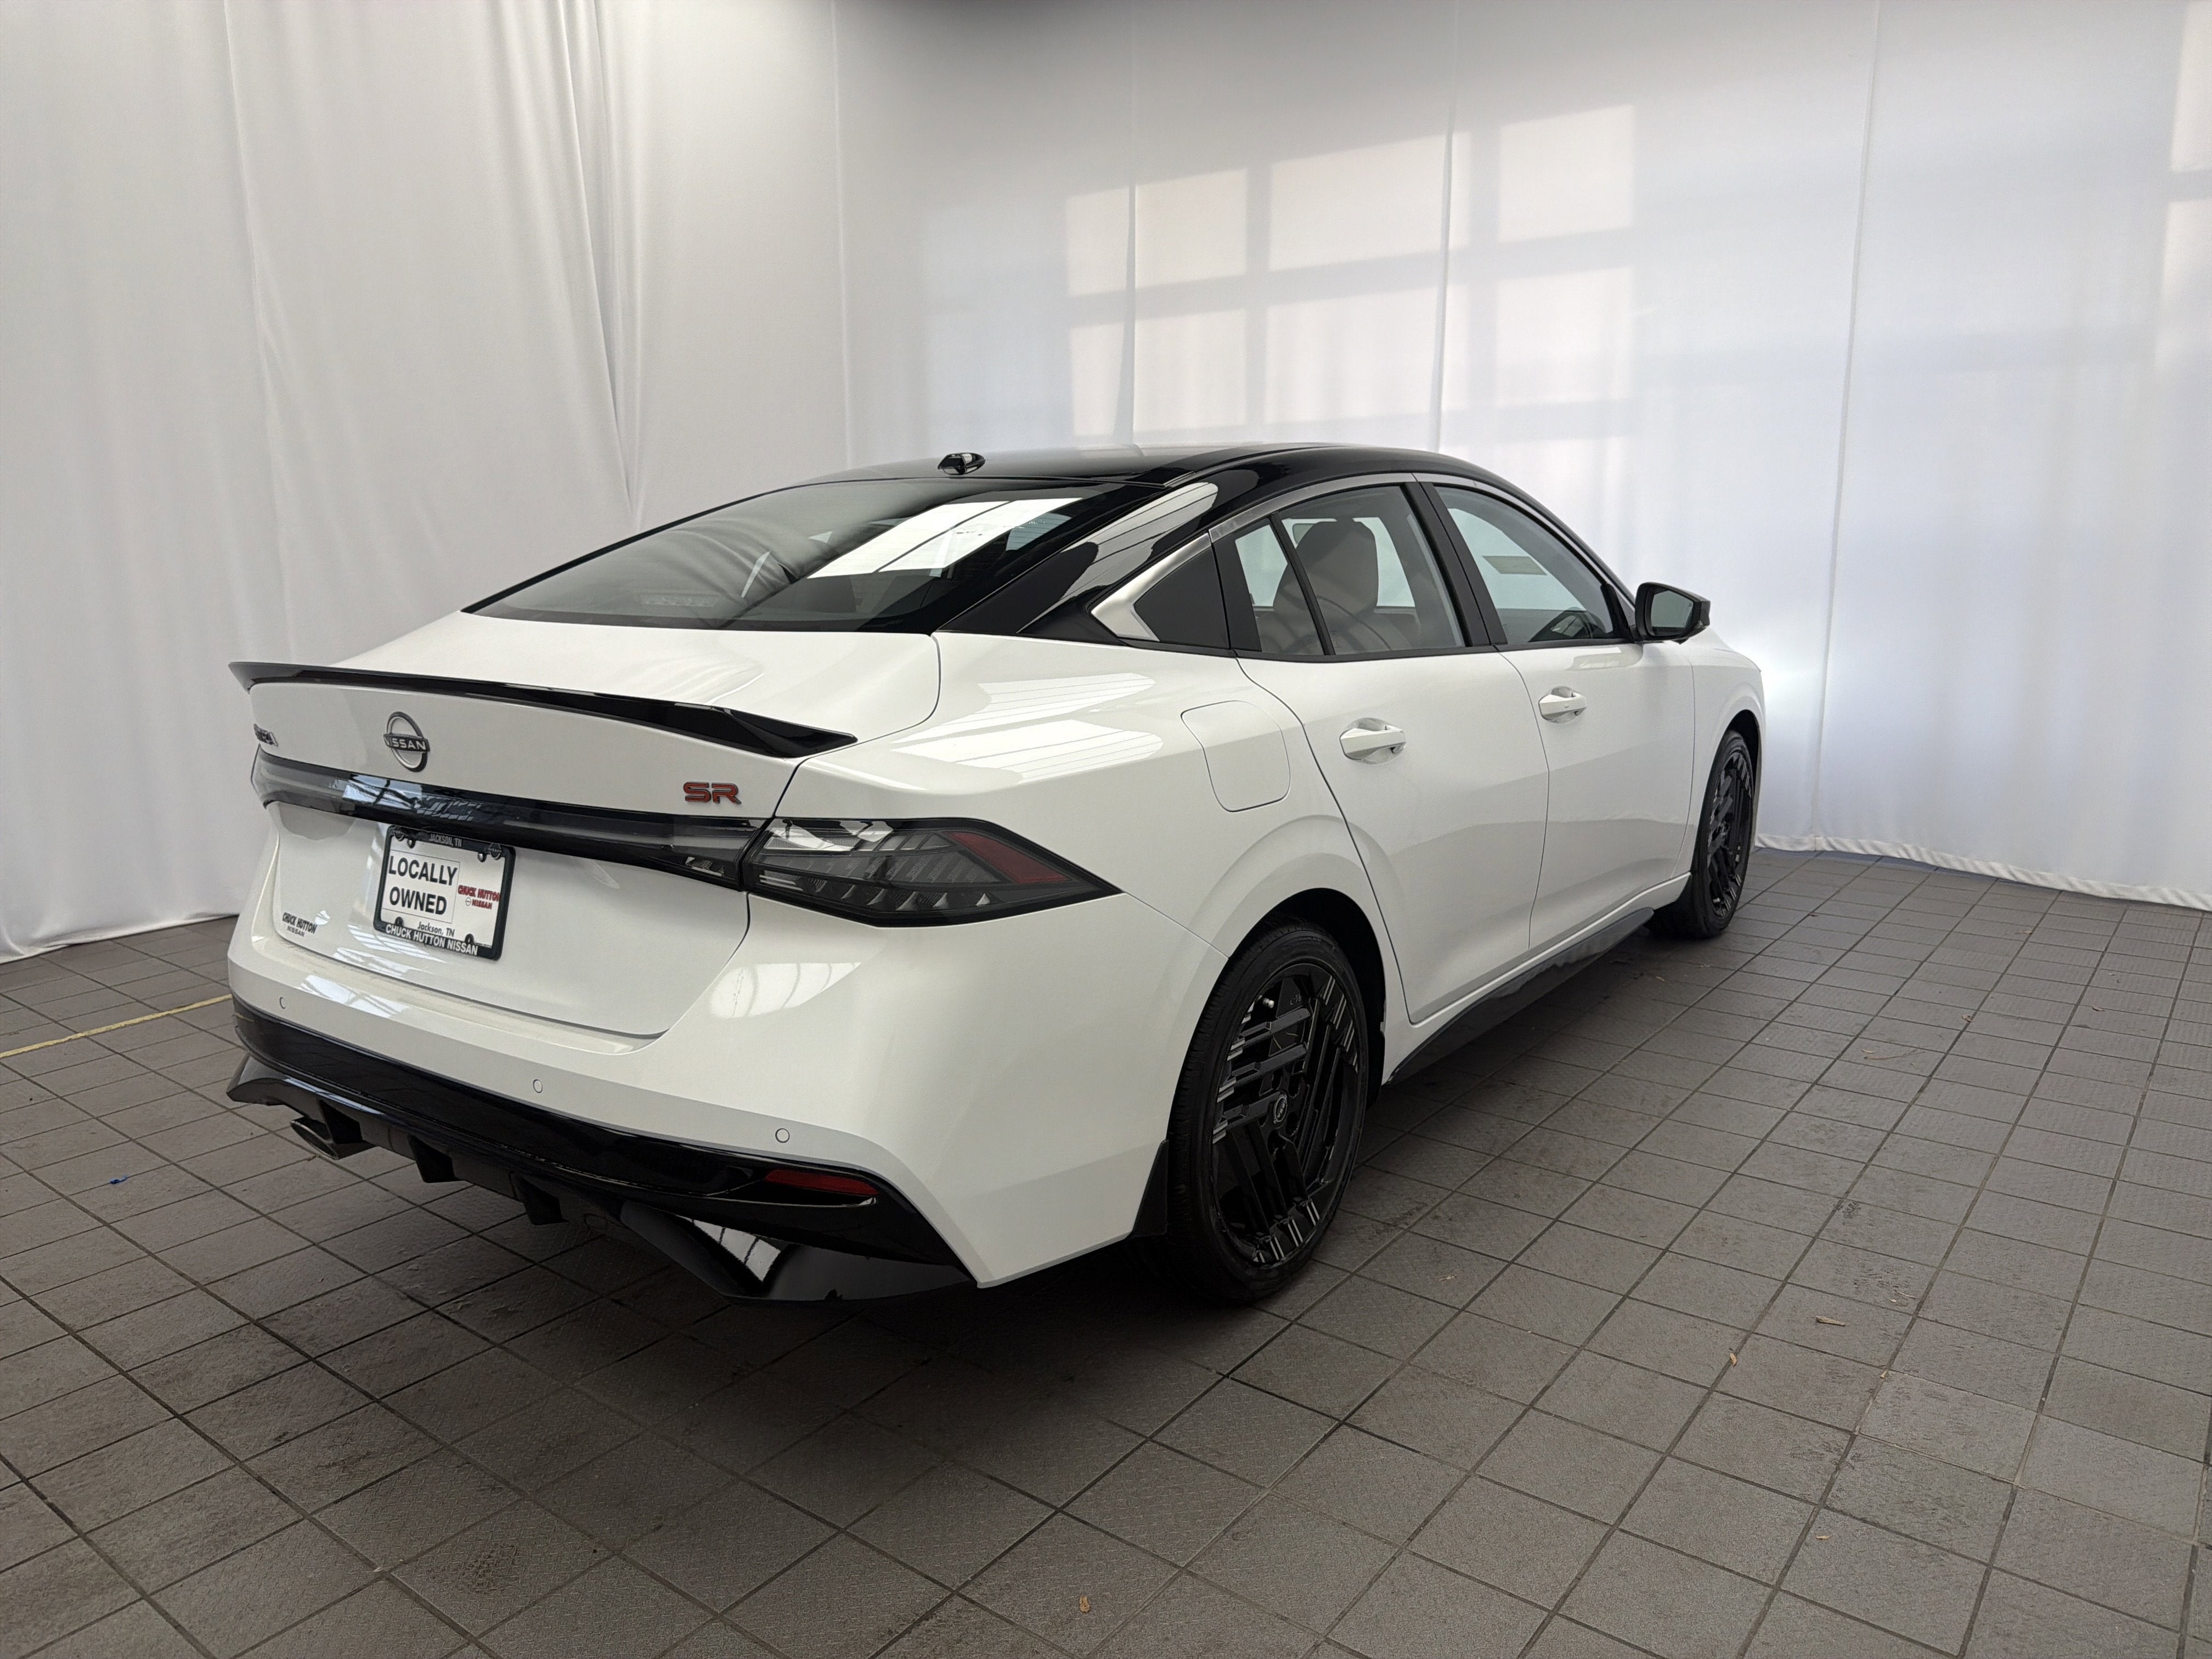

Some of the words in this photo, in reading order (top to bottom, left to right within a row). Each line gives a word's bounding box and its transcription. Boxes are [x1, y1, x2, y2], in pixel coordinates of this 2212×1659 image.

[384, 736, 427, 751] NISSAN
[683, 781, 742, 805] SR
[429, 834, 453, 847] JACKSON,
[454, 838, 462, 848] TN
[388, 855, 458, 885] LOCALLY
[458, 884, 477, 897] CHUCK
[390, 886, 447, 915] OWNED
[472, 899, 493, 910] NISSAN
[283, 912, 297, 926] CHUCK
[296, 917, 318, 934] HUTTON
[287, 925, 305, 937] NISSAN
[417, 921, 444, 936] Jackson,
[446, 927, 455, 938] TN
[386, 924, 412, 939] CHUCK
[413, 931, 445, 949] HUTTON
[447, 940, 478, 956] NISSAN
